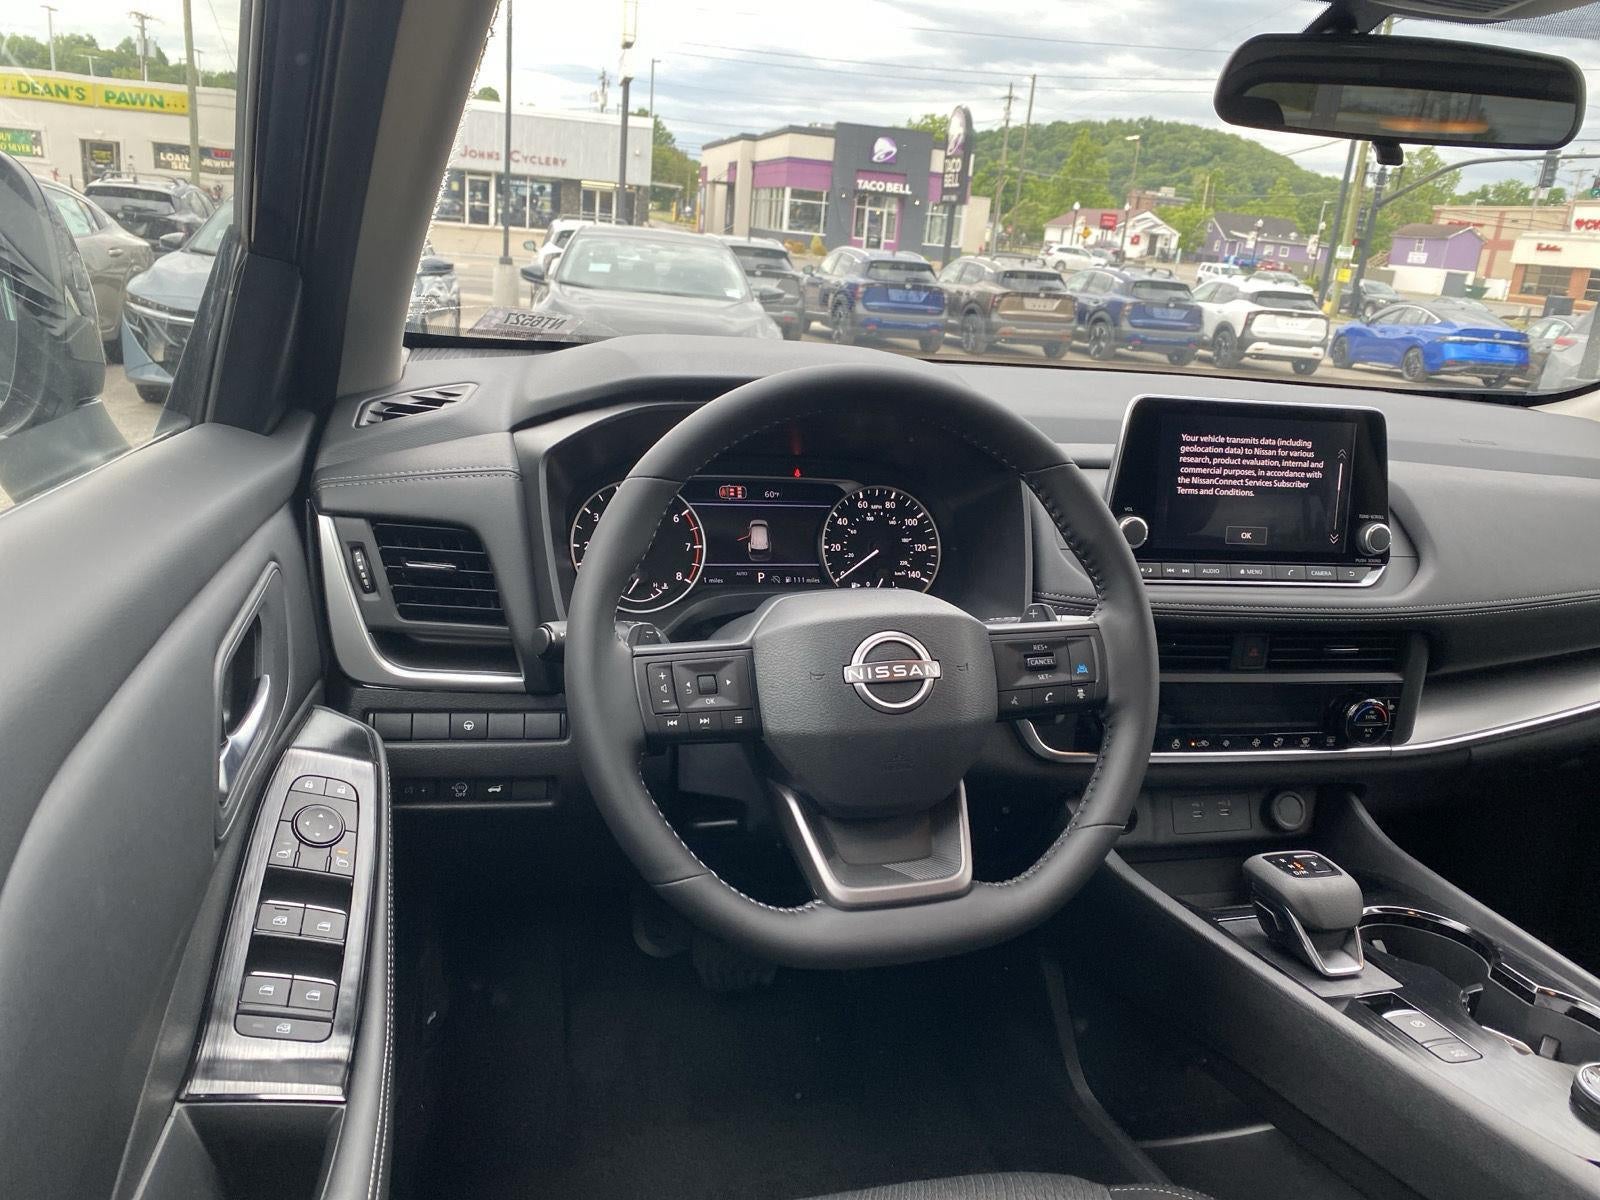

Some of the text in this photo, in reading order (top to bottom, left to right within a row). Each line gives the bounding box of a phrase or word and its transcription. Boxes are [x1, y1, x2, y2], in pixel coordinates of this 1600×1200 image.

[17, 80, 86, 101] DEAN'S
[857, 180, 912, 195] TACO BELL
[1200, 435, 1225, 443] vehicle
[1277, 438, 1312, 448] (including
[1180, 445, 1223, 454] geolocation
[1225, 446, 1244, 455] data)
[1254, 448, 1276, 456] Nissan
[1278, 448, 1288, 456] for
[1290, 450, 1314, 458] various
[1180, 456, 1211, 464] research,
[1213, 457, 1241, 465] product
[1242, 458, 1280, 467] evaluation,
[1282, 460, 1309, 468] internal
[1178, 476, 1309, 488] the NissanConnect Services Subscriber
[1177, 487, 1199, 495] Terms
[1215, 488, 1254, 496] Conditions.
[594, 513, 599, 522] 3
[673, 514, 680, 523] 6
[837, 518, 848, 526] 40
[1241, 532, 1252, 540] OK
[685, 543, 691, 551] 7
[914, 544, 927, 552] 120
[676, 572, 682, 580] 8
[757, 572, 765, 583] P
[848, 664, 937, 680] NISSAN
